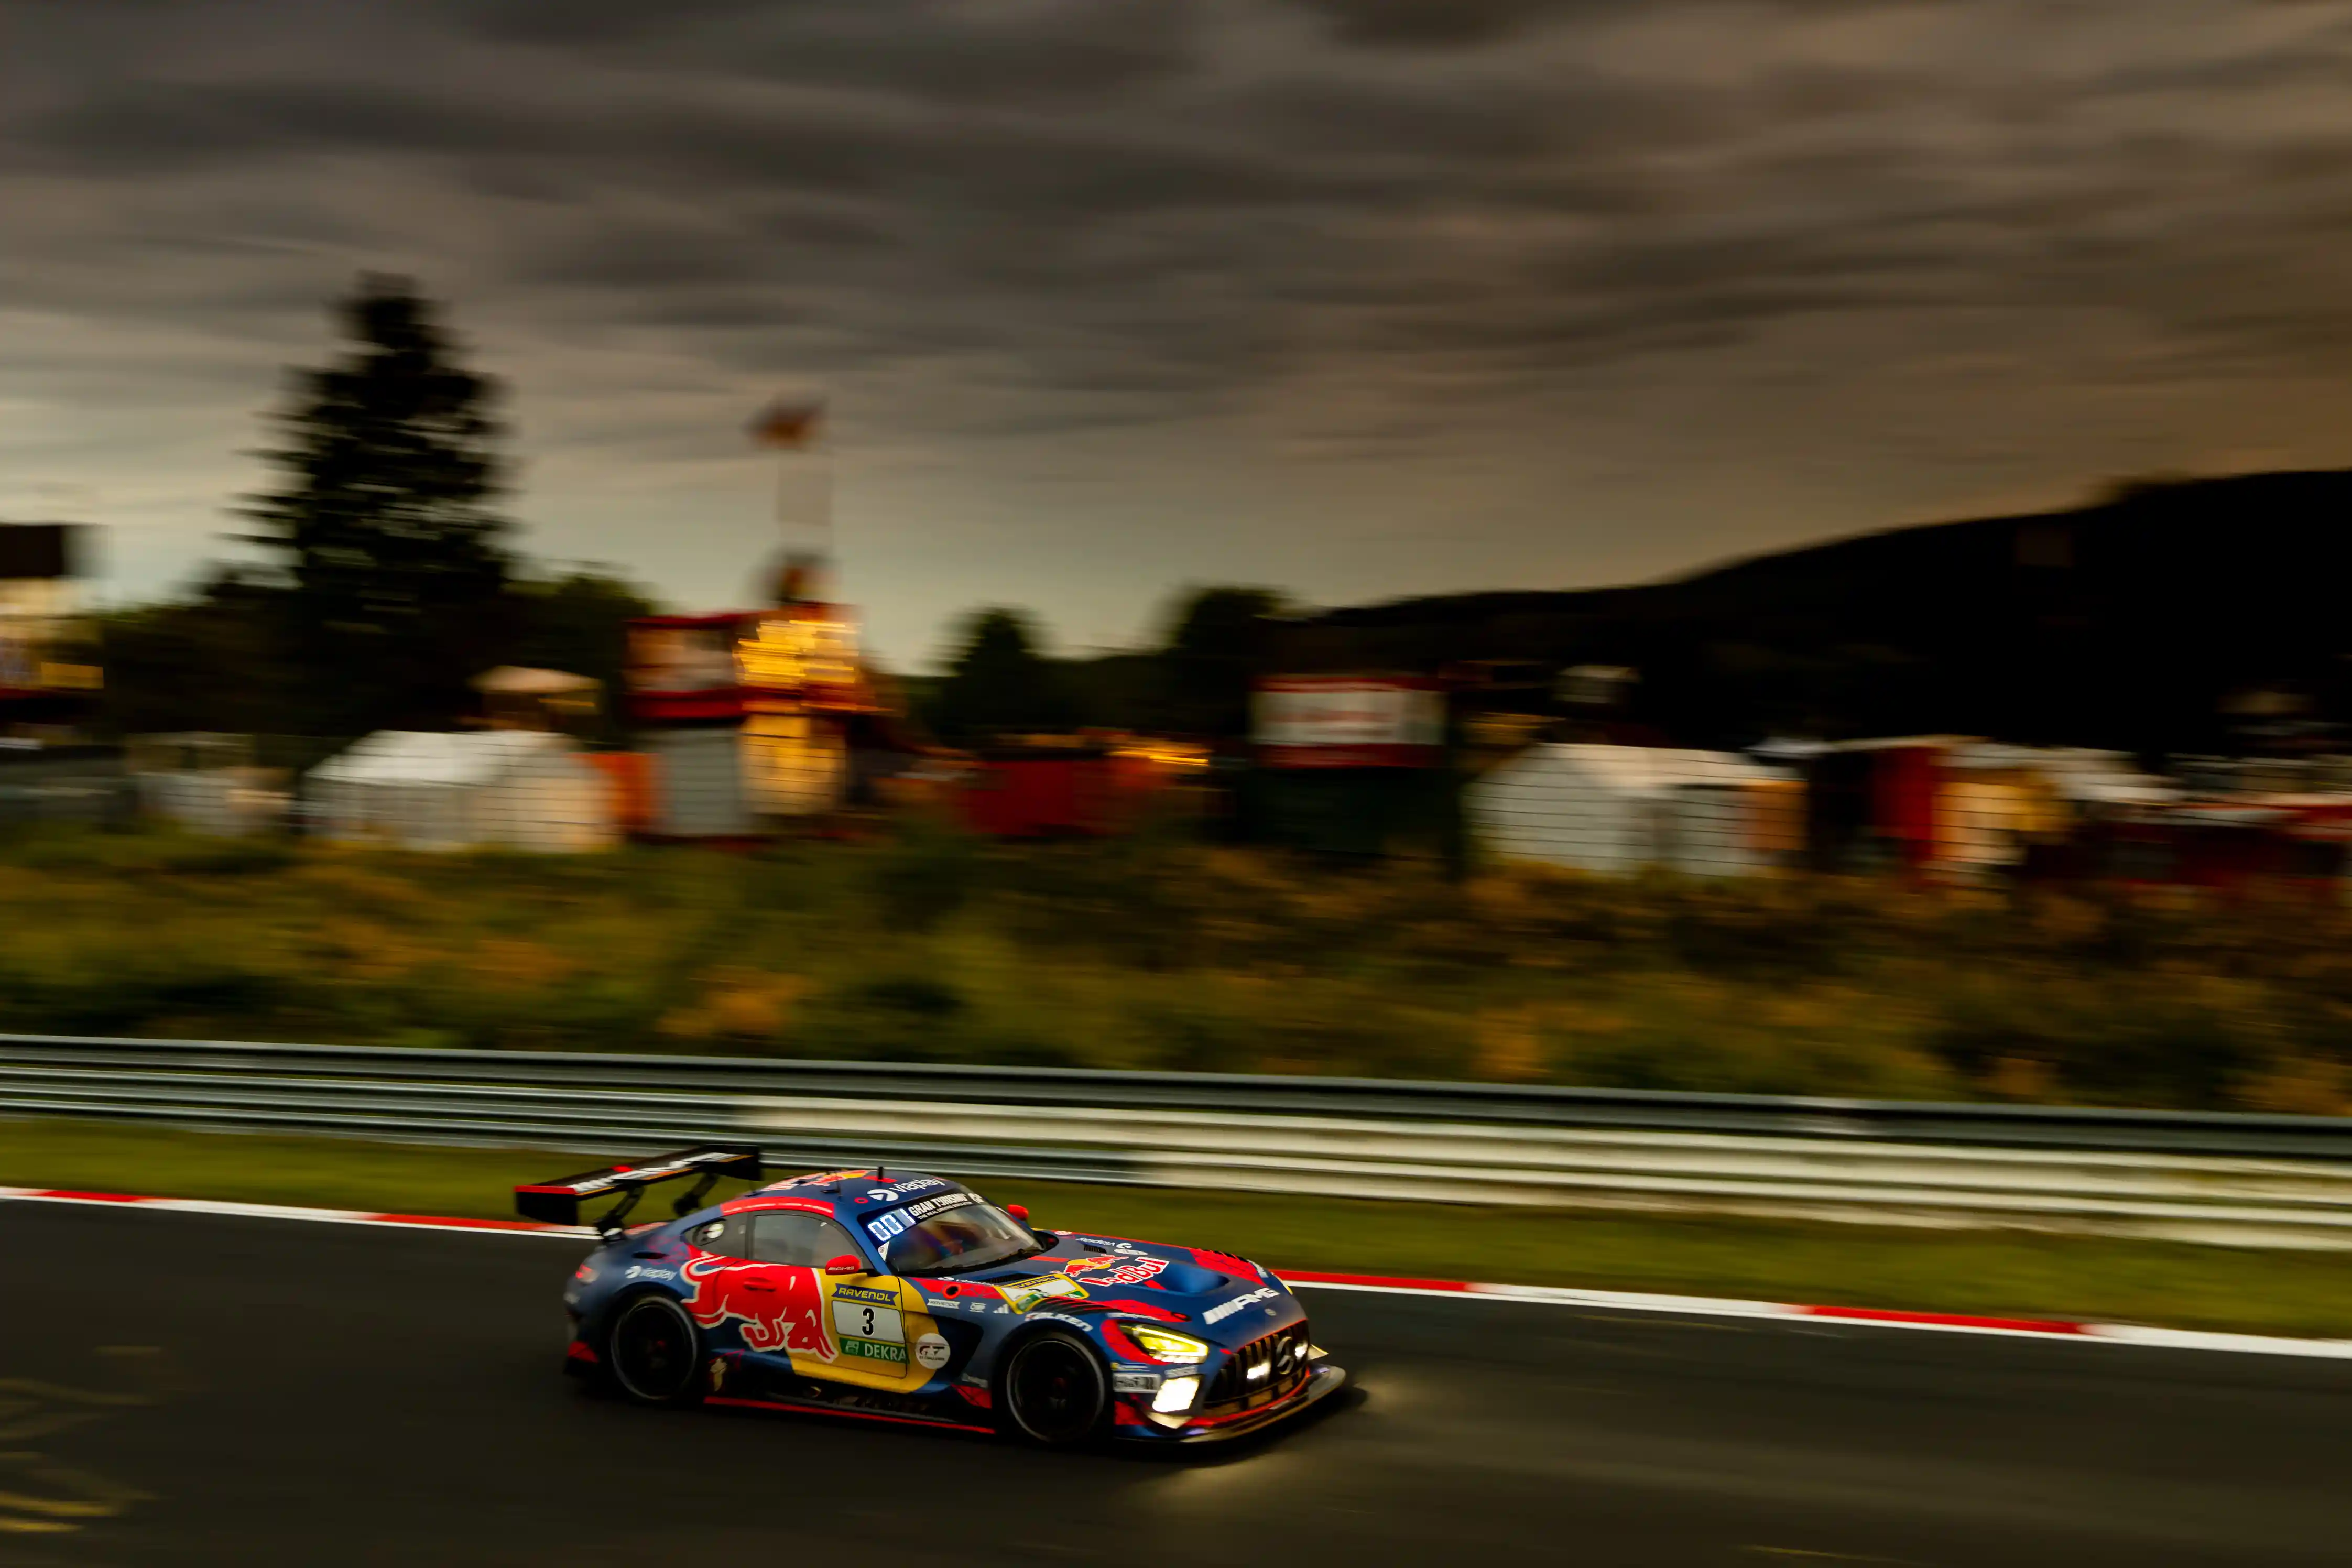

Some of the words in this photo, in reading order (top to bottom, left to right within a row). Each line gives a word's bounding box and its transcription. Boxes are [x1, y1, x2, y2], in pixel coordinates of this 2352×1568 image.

[908, 1200, 936, 1216] GRAN
[868, 1208, 916, 1242] 001
[1013, 1275, 1055, 1288] VENOL
[838, 1287, 891, 1302] RAVENOL
[861, 1308, 875, 1336] 3
[864, 1343, 907, 1362] DEKRA
